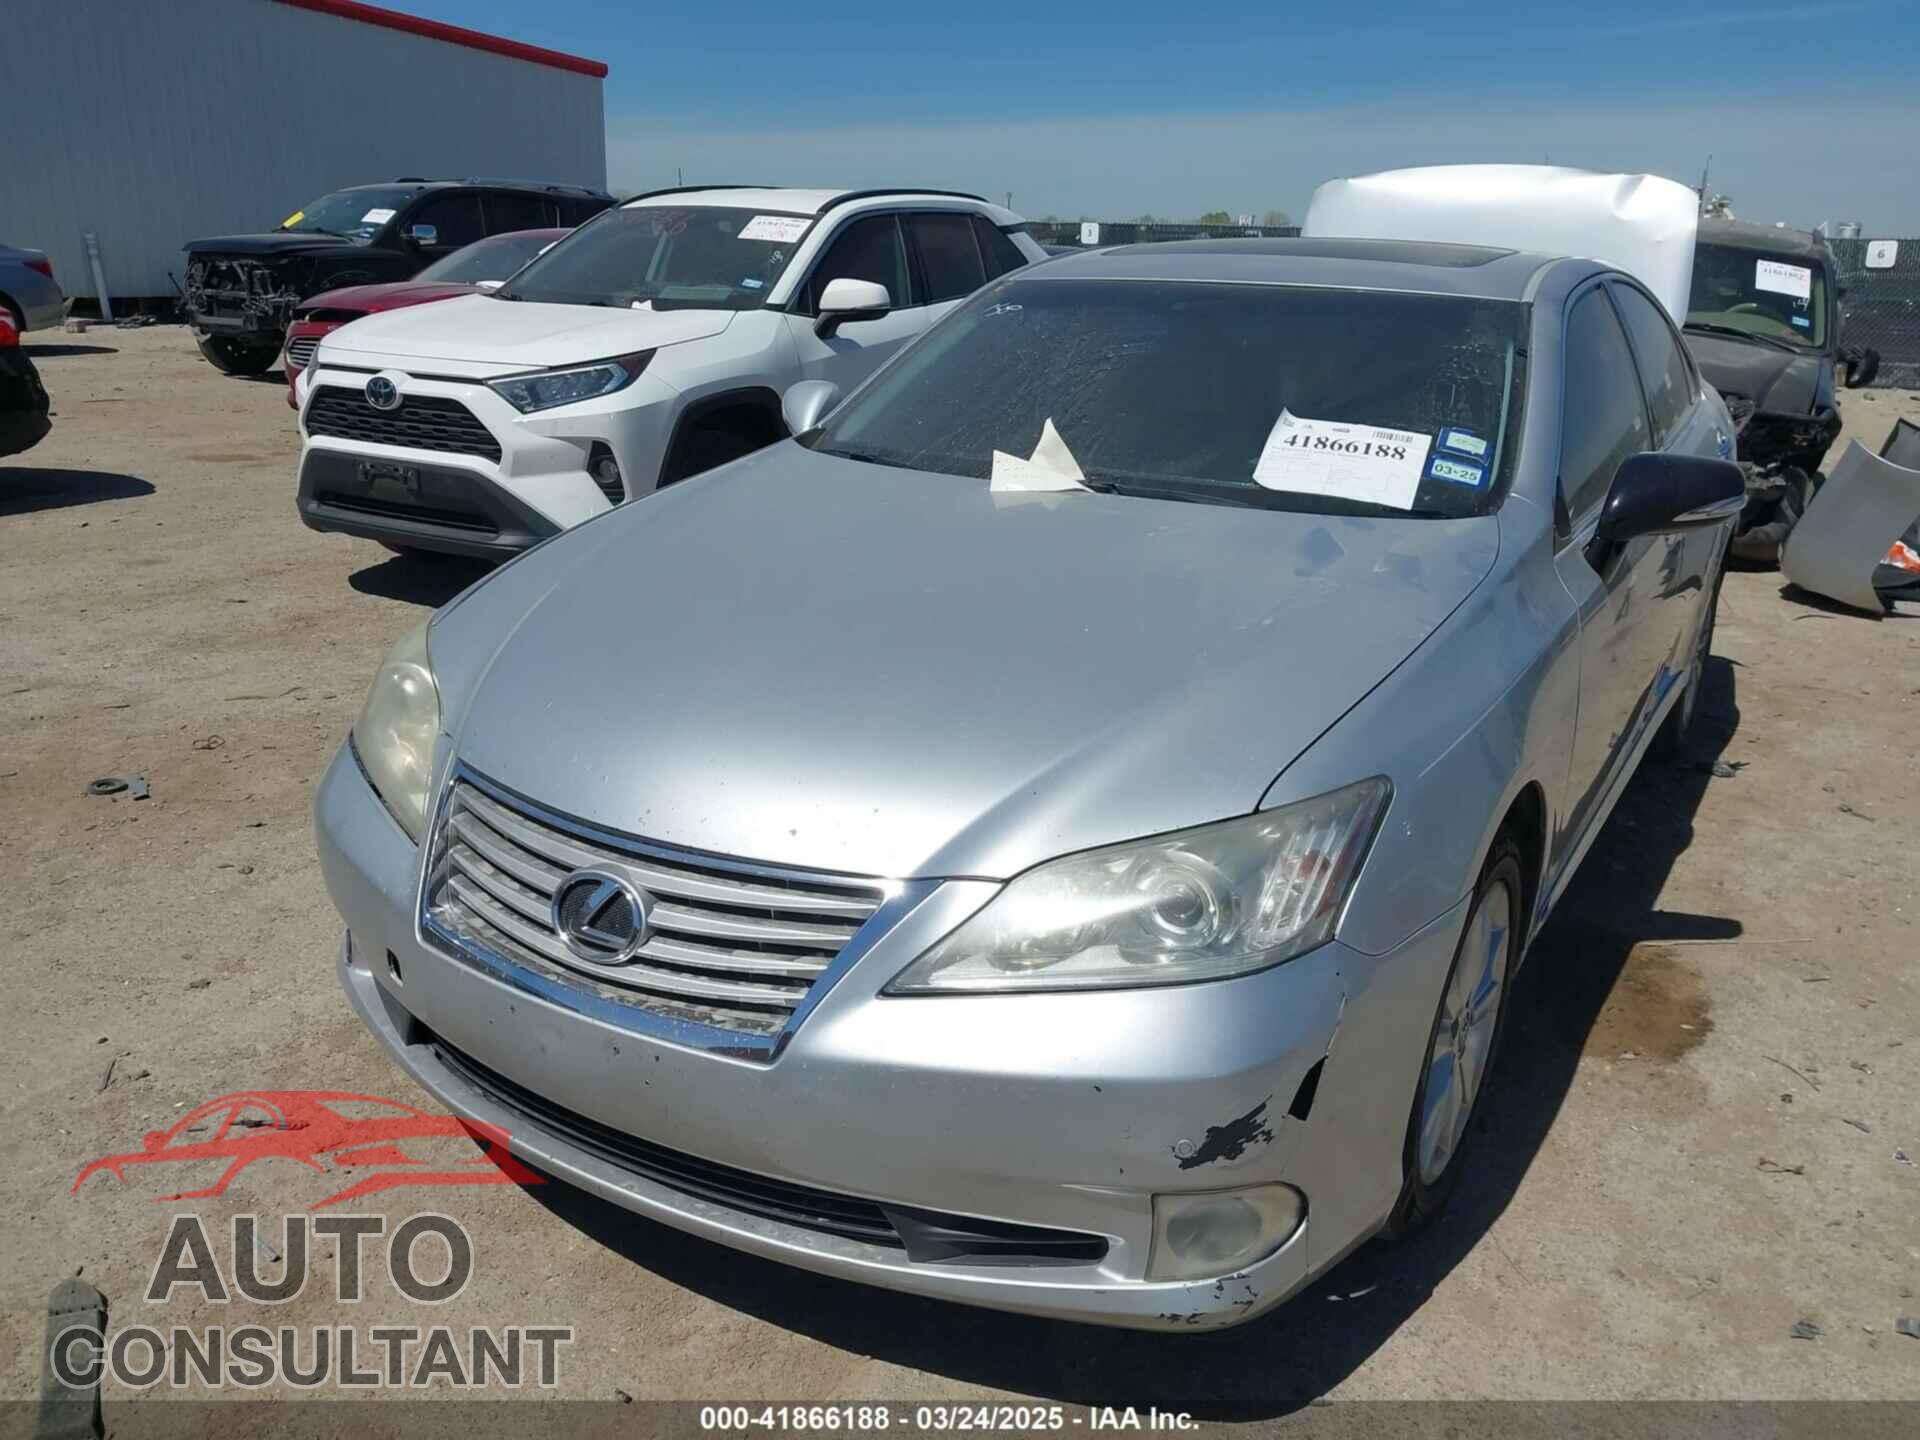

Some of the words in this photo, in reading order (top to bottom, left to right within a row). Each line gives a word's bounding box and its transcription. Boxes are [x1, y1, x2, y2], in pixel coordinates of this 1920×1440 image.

[1877, 250, 1886, 259] 6
[1283, 433, 1407, 461] 41866188
[1434, 463, 1478, 481] 03-25
